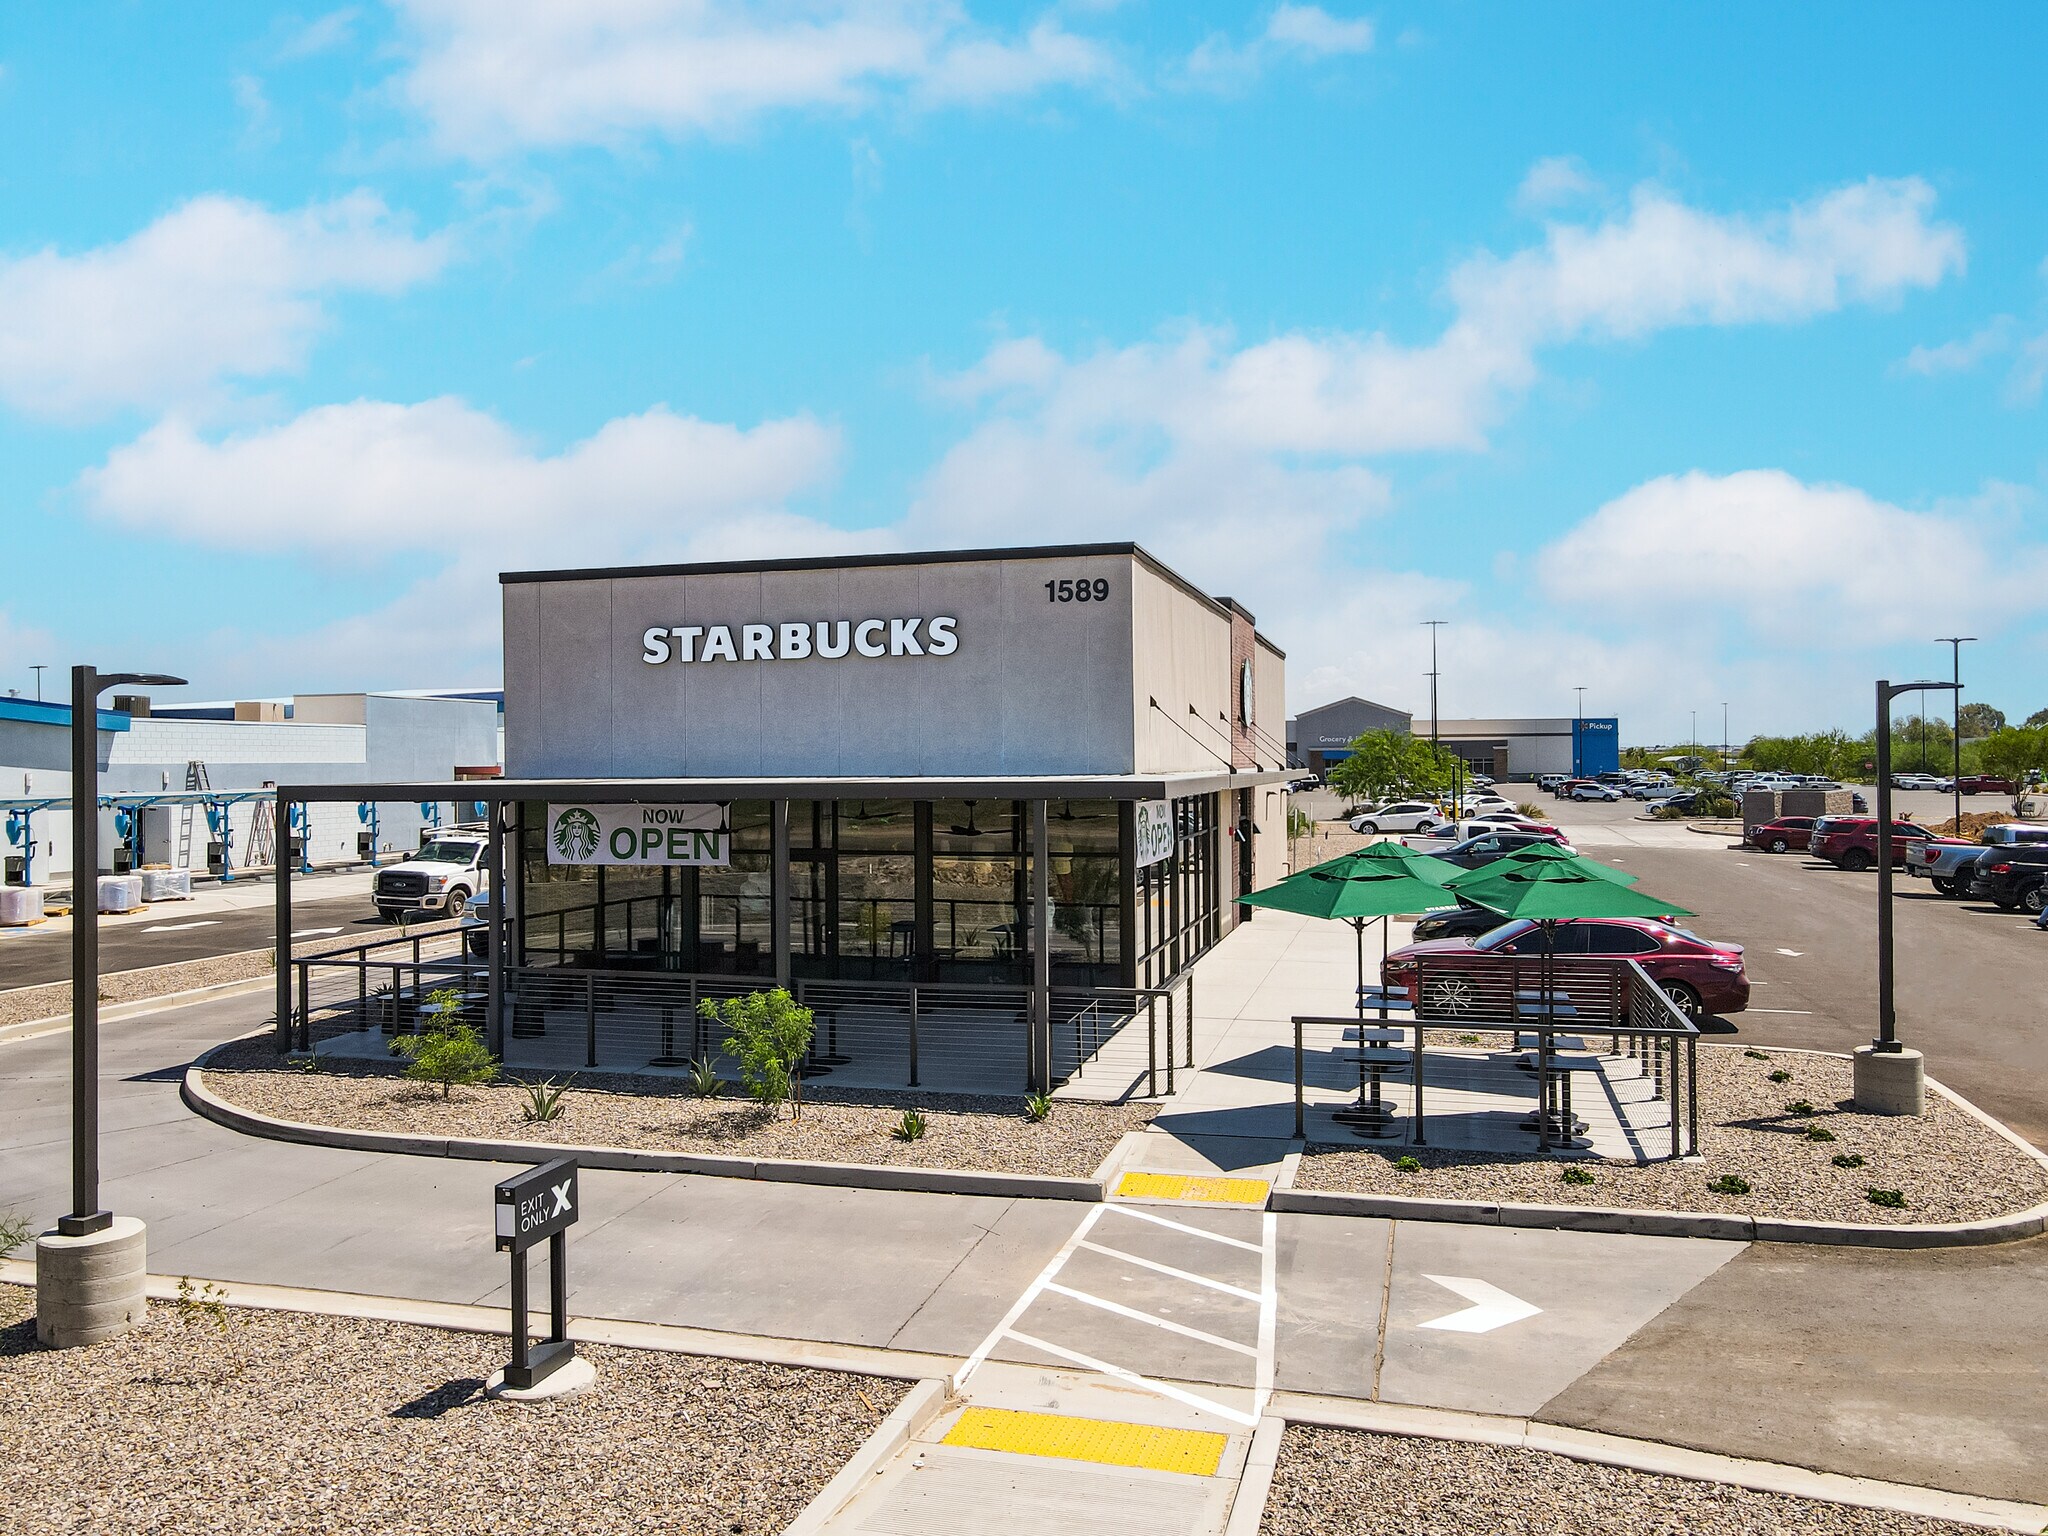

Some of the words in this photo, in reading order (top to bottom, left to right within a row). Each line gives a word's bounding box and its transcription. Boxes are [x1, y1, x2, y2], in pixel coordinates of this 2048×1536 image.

[1044, 578, 1109, 602] 1589
[642, 616, 960, 664] STARBUCKS
[1589, 722, 1613, 731] Pickup
[1319, 735, 1346, 744] Grocery
[1347, 735, 1353, 743] &
[642, 809, 685, 824] NOW
[609, 827, 720, 860] OPEN
[1151, 822, 1173, 857] OPEN
[521, 1193, 544, 1216] EXIT
[521, 1206, 550, 1232] ONLY
